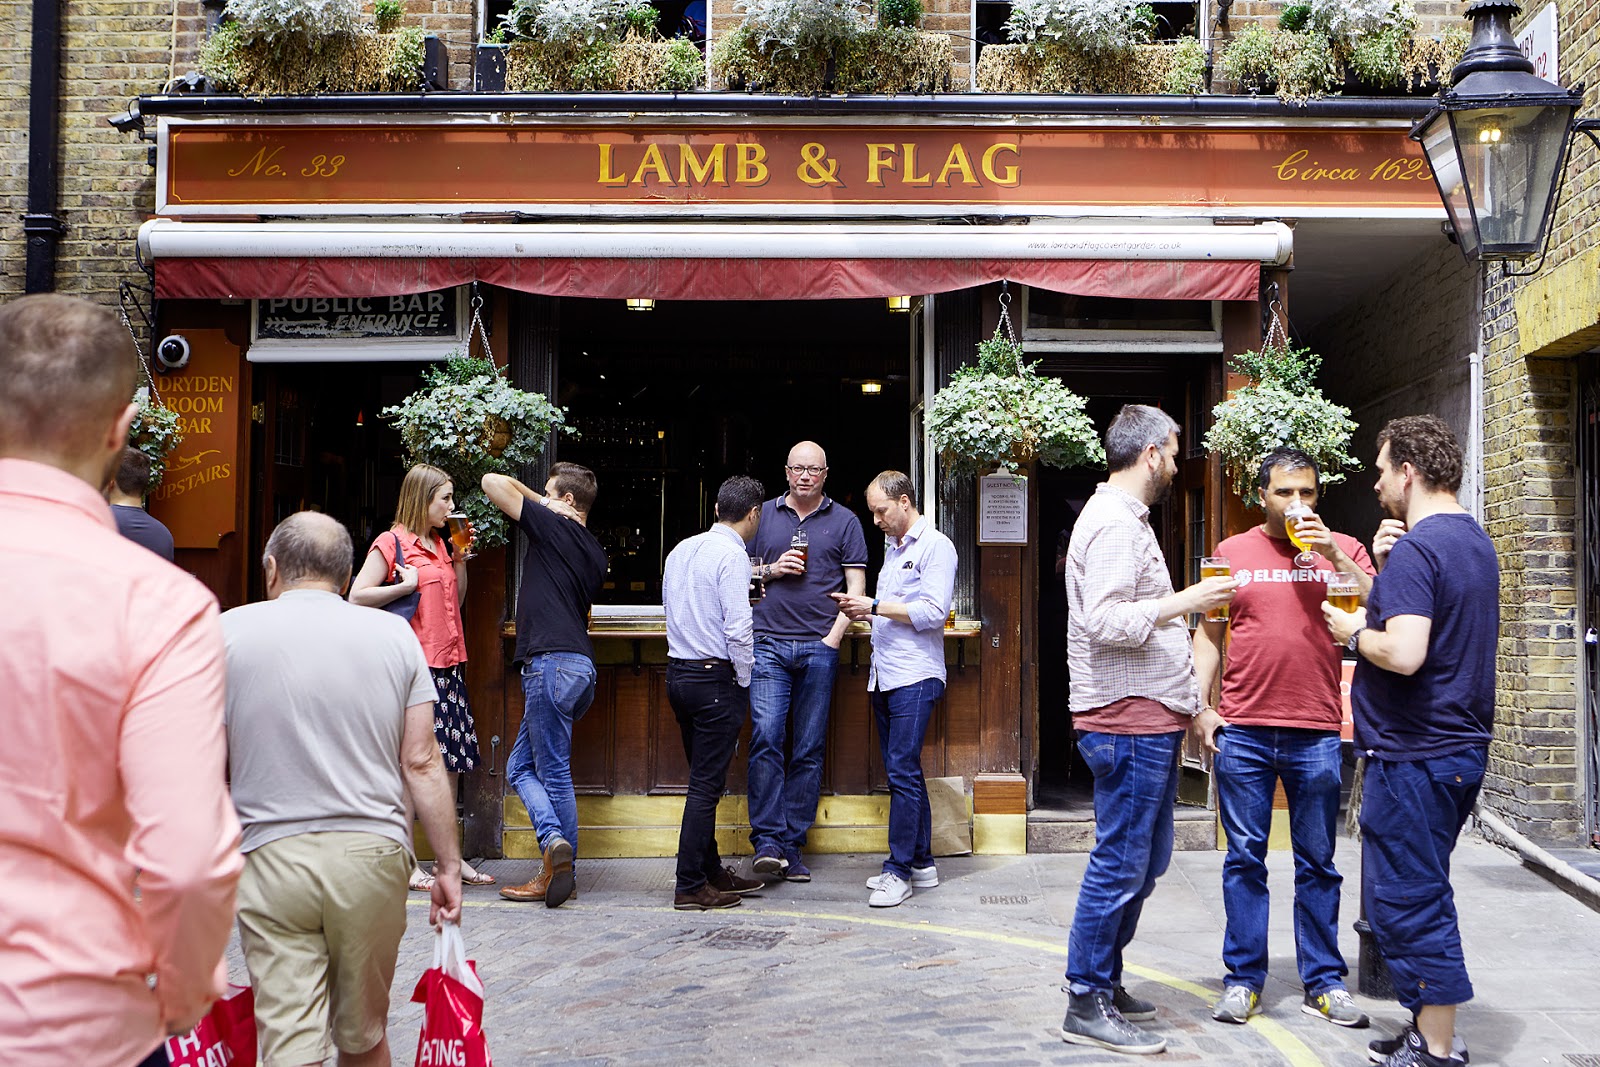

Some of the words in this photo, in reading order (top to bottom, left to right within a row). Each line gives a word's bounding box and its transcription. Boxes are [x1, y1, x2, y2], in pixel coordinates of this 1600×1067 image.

[227, 145, 287, 177] No.
[301, 154, 346, 177] 33
[597, 142, 771, 187] LAMB
[796, 142, 843, 187] &
[866, 142, 1022, 187] FLAG
[1271, 149, 1361, 181] Circa
[269, 296, 373, 314] PUBLIC
[389, 292, 445, 312] BAR
[158, 376, 234, 393] DRYDEN
[166, 396, 224, 414] ROOM
[176, 417, 213, 434] BAR
[156, 463, 232, 501] UPSTAIRS
[1253, 568, 1332, 583] ELEMENT
